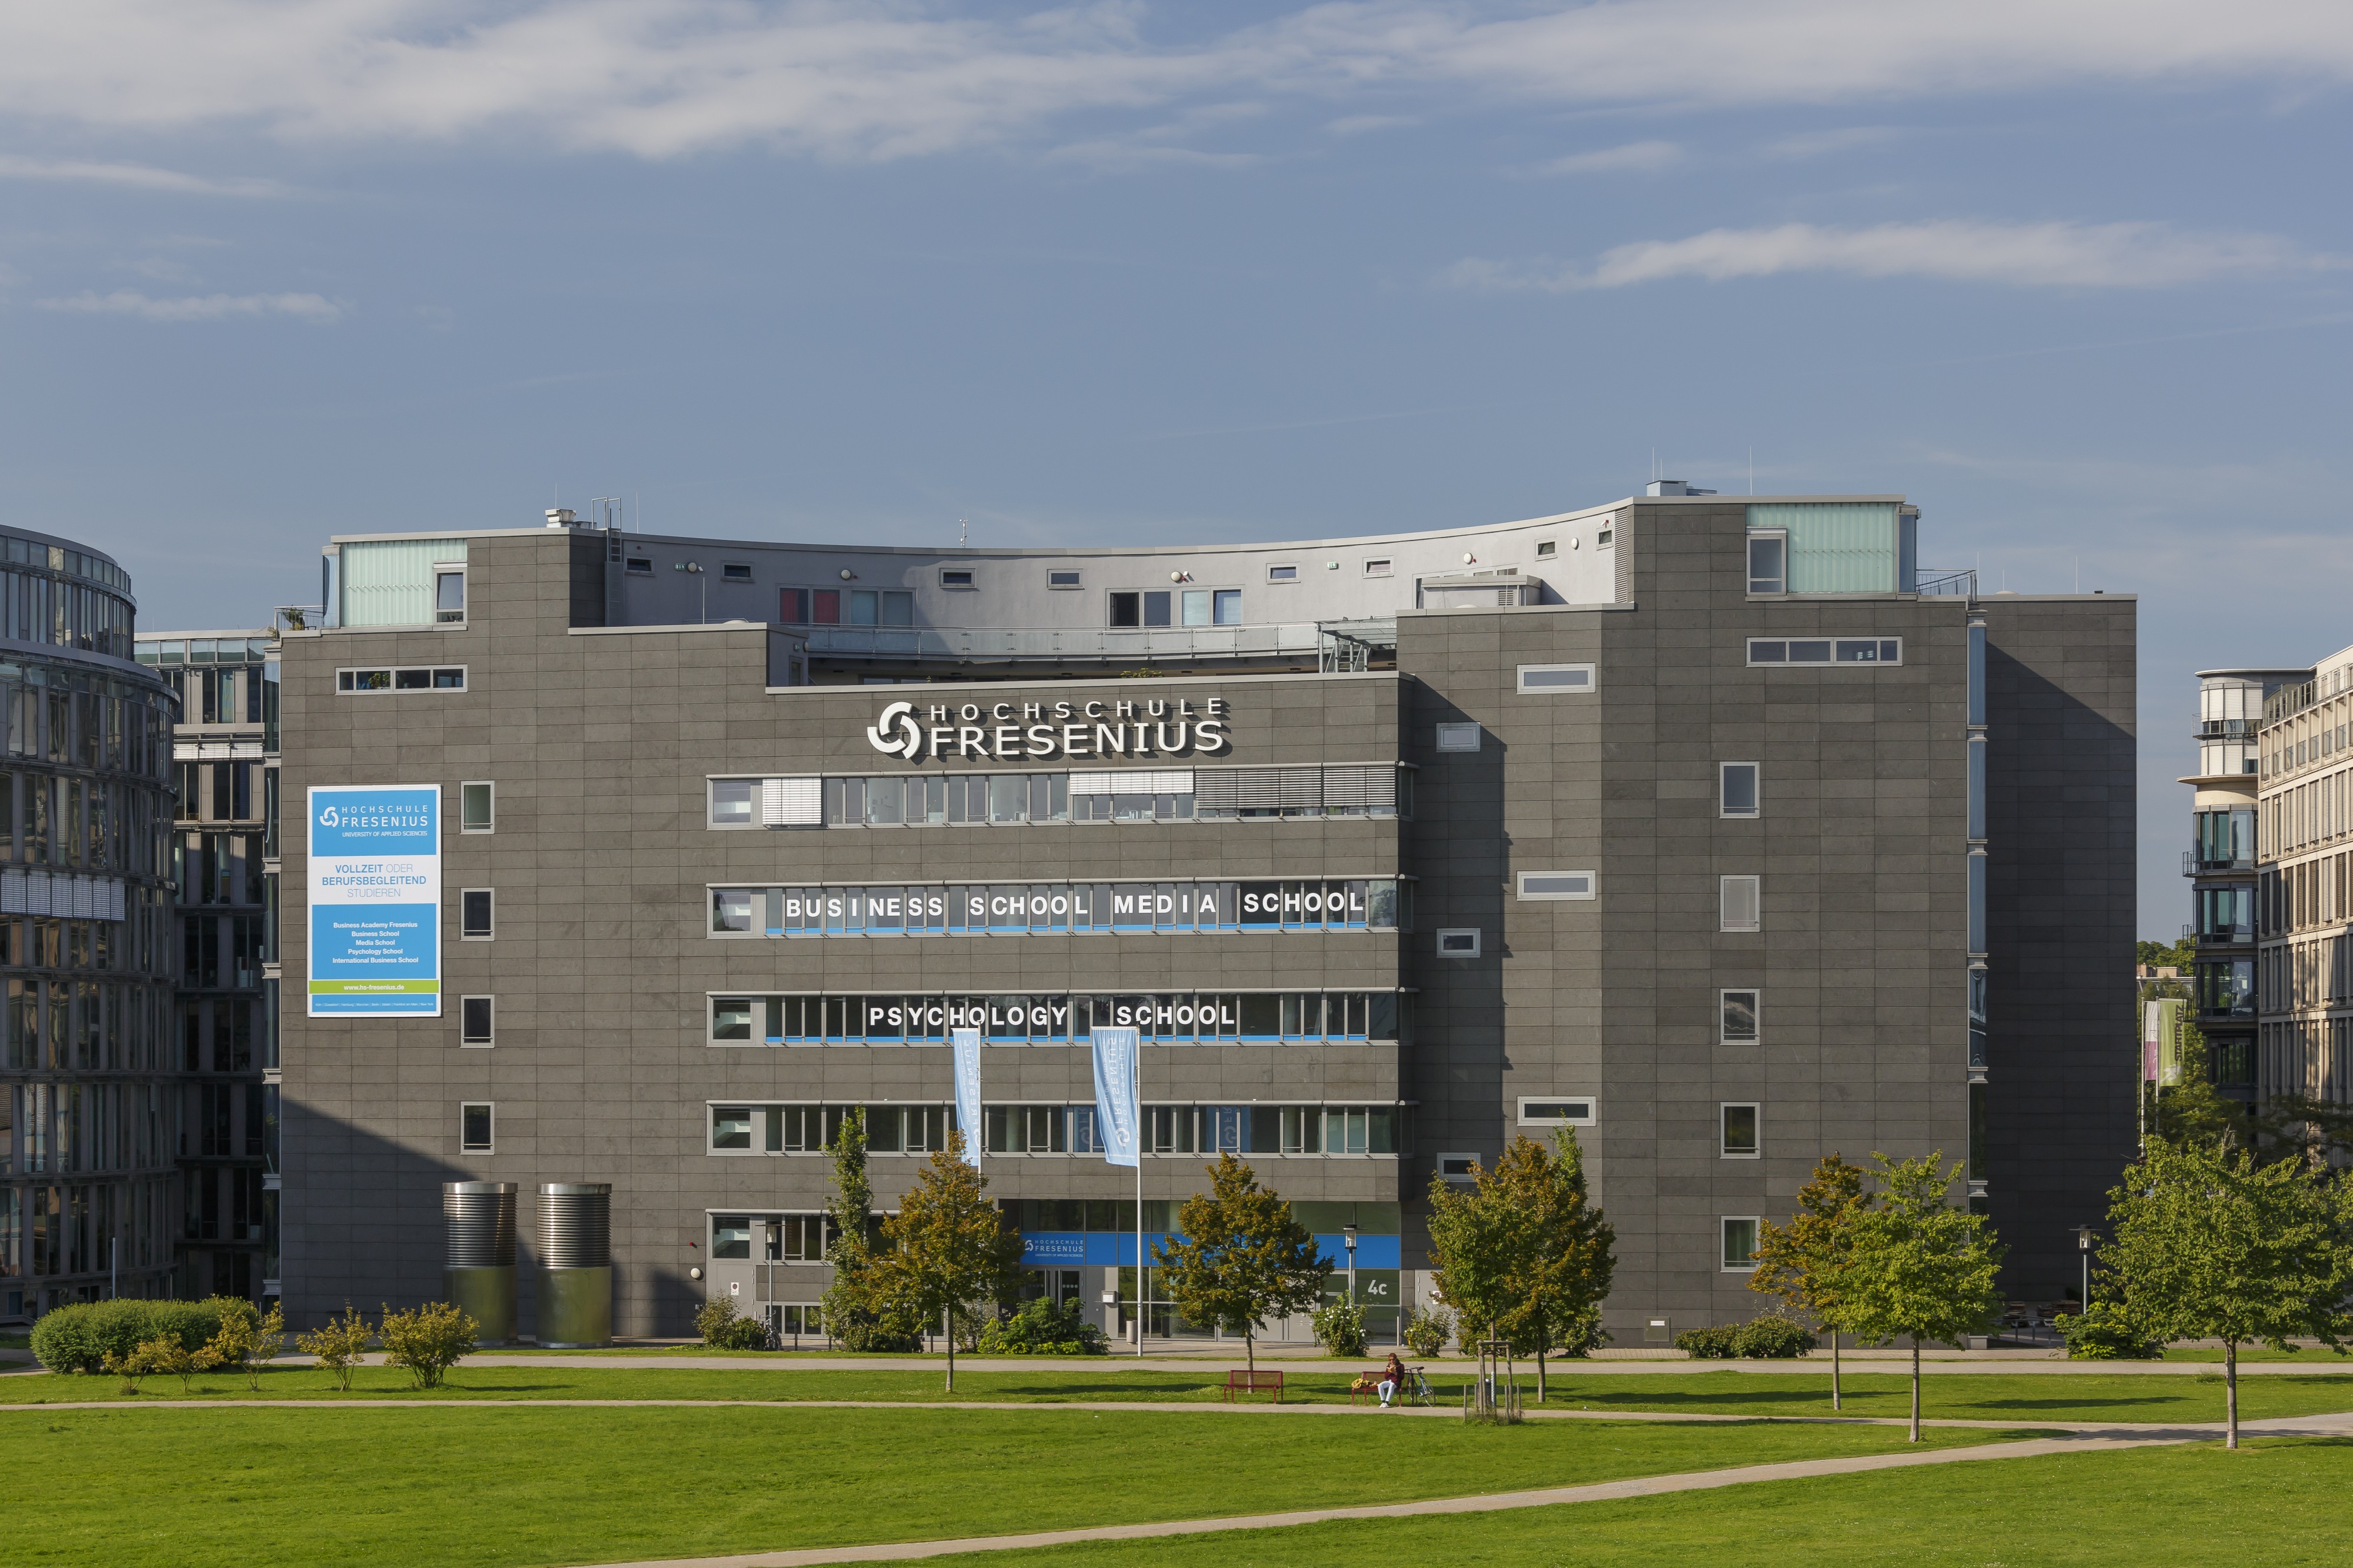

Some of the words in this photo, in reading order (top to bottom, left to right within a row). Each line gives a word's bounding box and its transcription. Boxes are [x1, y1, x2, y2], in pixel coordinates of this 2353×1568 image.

[931, 698, 1222, 721] HOCHSCHULE
[931, 720, 1223, 756] FRESENIUS
[342, 805, 428, 813] HOCHSCHULE
[342, 816, 428, 828] FRESENIUS
[335, 864, 384, 873] VOLLZEIT
[386, 863, 413, 873] ODER
[322, 876, 426, 886] BERUFSBEGLEITEND
[347, 888, 401, 898] STUDIEREN
[786, 896, 943, 918] BUSINESS
[969, 896, 1088, 916] SCHOOL
[1114, 894, 1217, 914] MEDIA
[1244, 892, 1364, 913] SCHOOL
[870, 1007, 1068, 1026] PSYCHOLOGY
[1116, 1006, 1235, 1026] SCHOOL
[2175, 1005, 2184, 1062] STARTPLATZ
[1368, 1279, 1388, 1295] 4c
